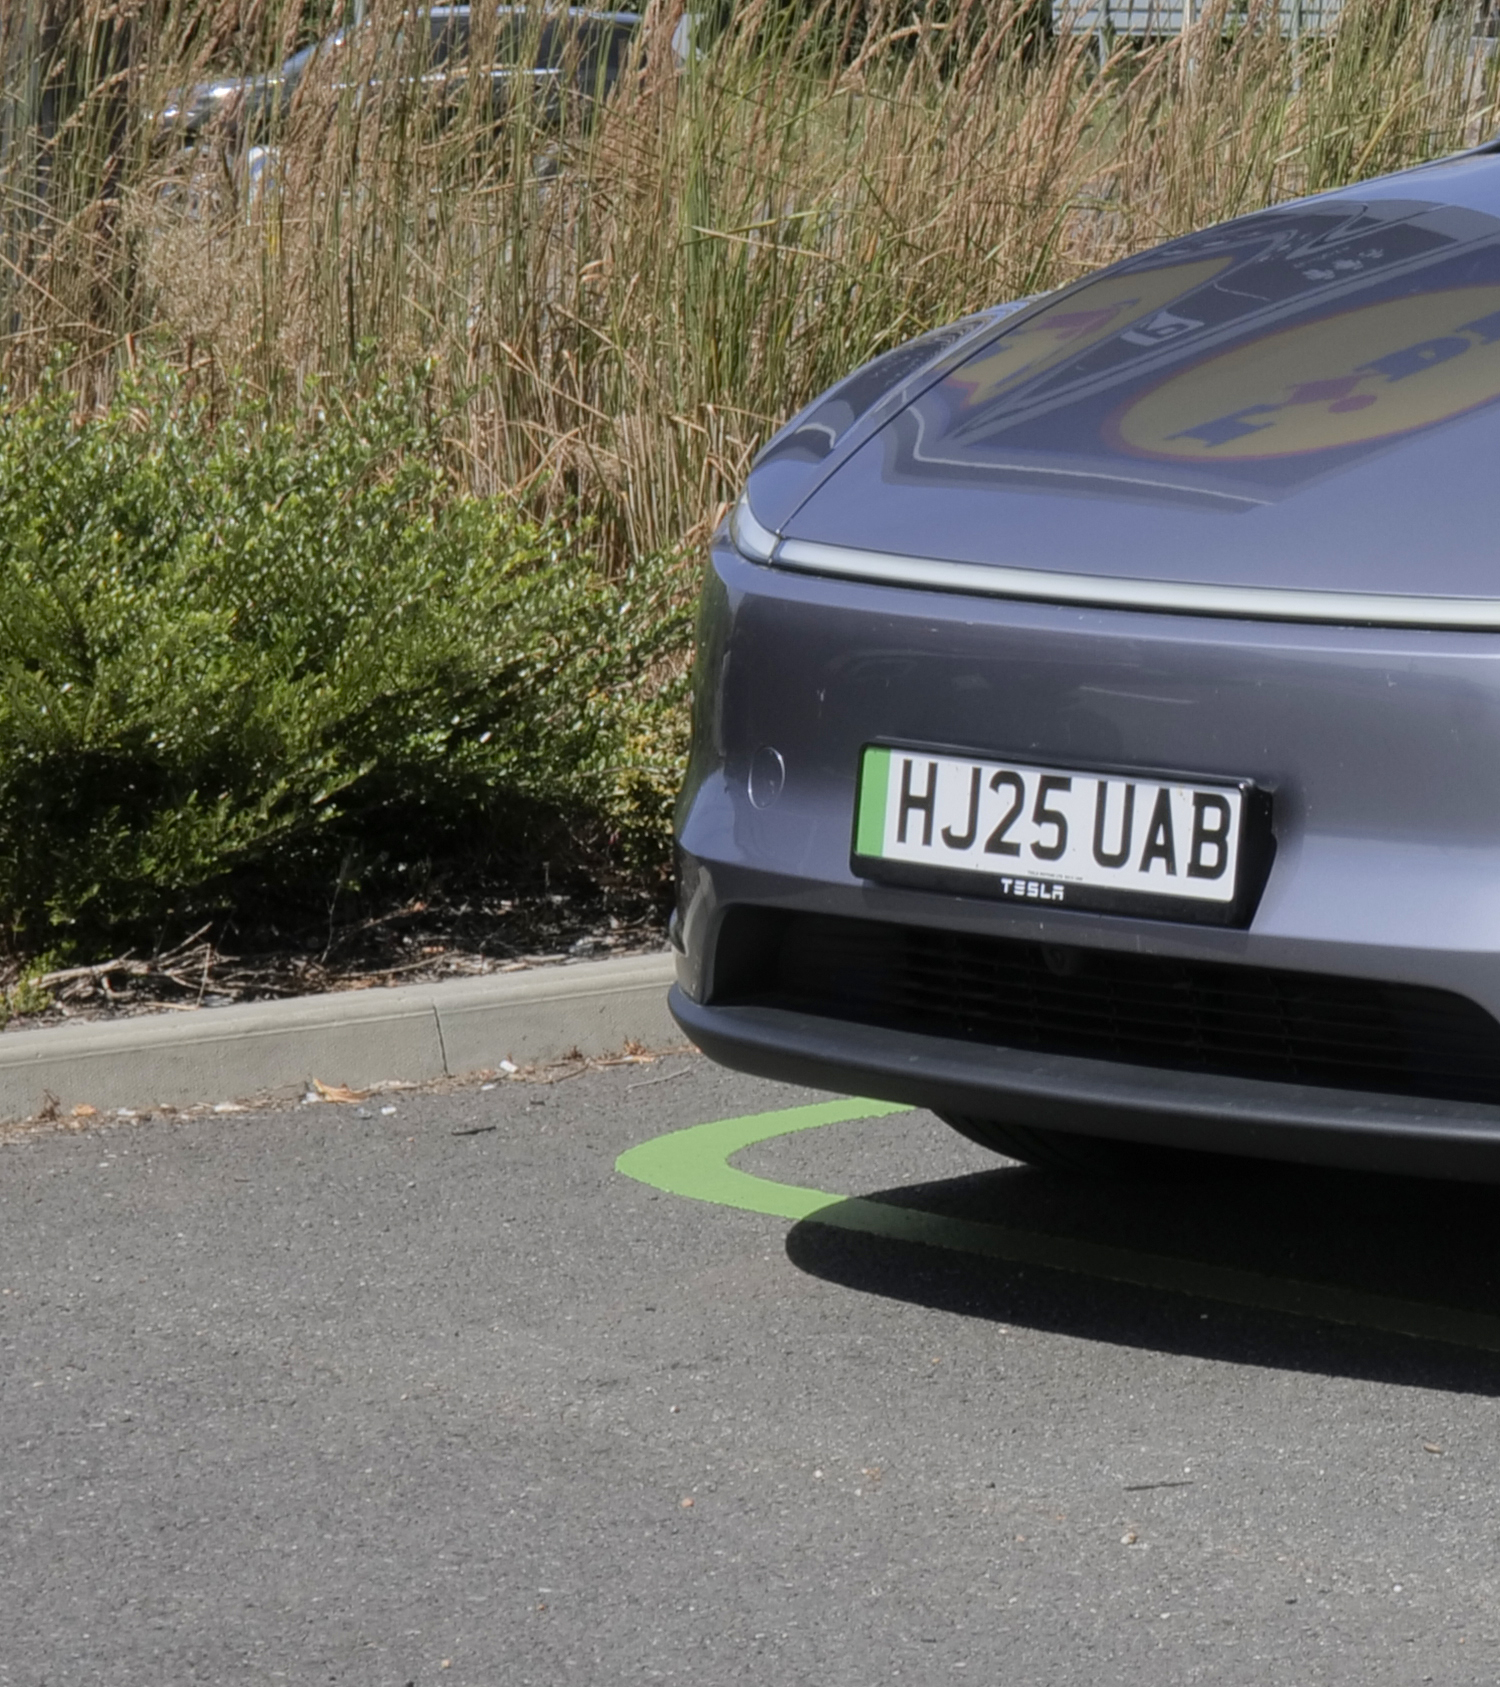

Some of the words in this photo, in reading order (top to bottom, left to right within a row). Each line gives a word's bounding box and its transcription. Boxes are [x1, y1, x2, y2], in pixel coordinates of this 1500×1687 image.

[896, 758, 1072, 861] HJ25
[1091, 778, 1231, 881] UAB
[1001, 877, 1064, 901] TESLA
